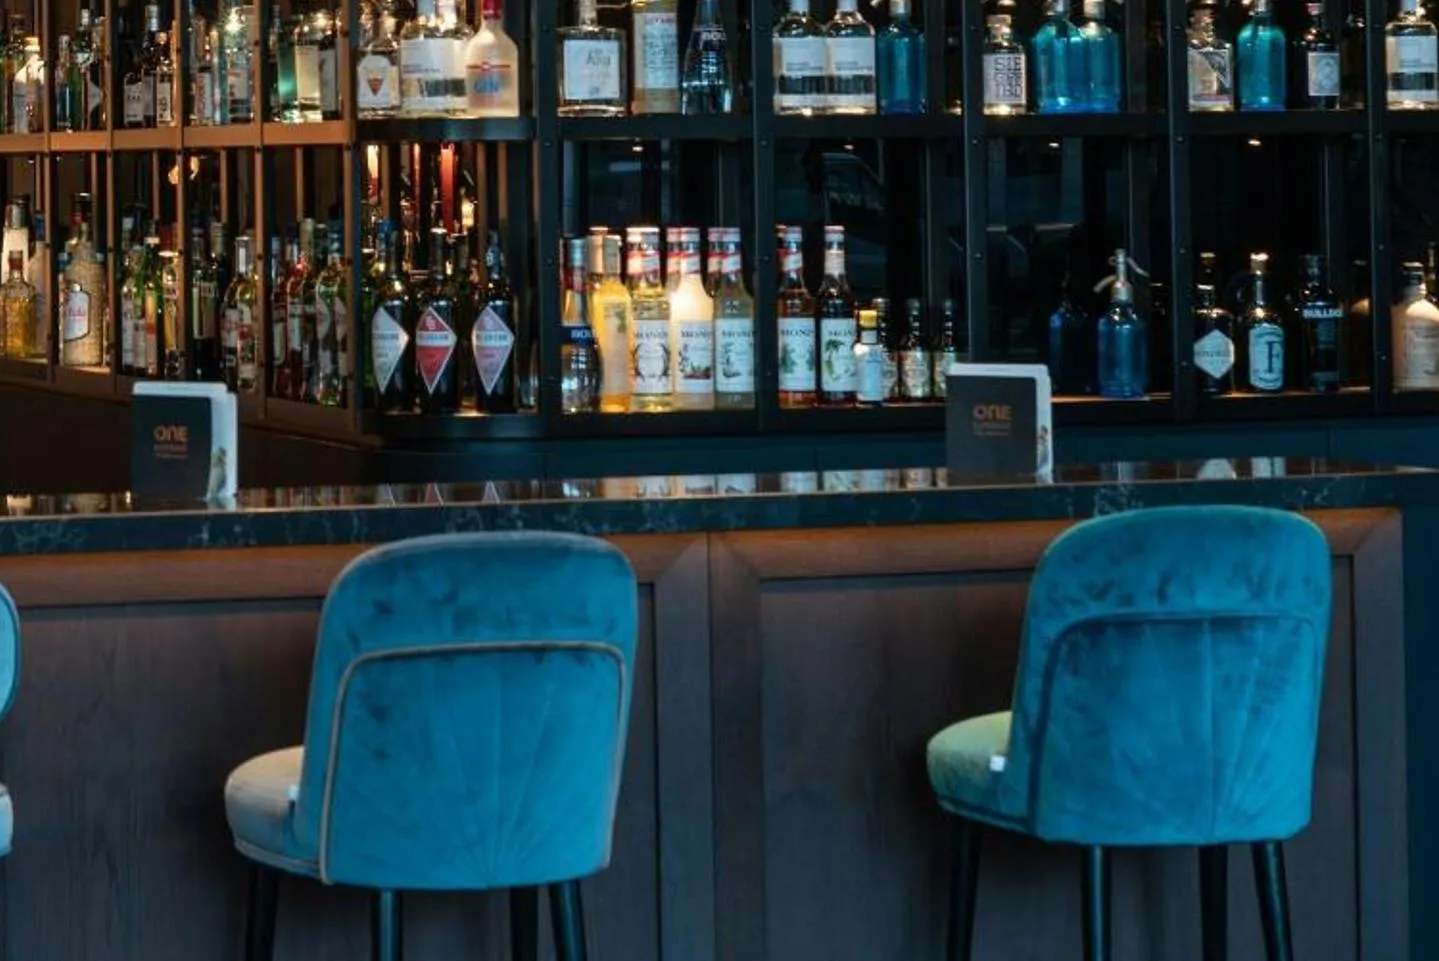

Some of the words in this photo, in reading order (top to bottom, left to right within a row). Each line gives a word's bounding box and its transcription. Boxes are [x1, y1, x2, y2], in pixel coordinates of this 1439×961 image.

[1303, 309, 1344, 318] BULLDO
[973, 404, 1012, 420] ONE
[153, 425, 188, 442] ONE
